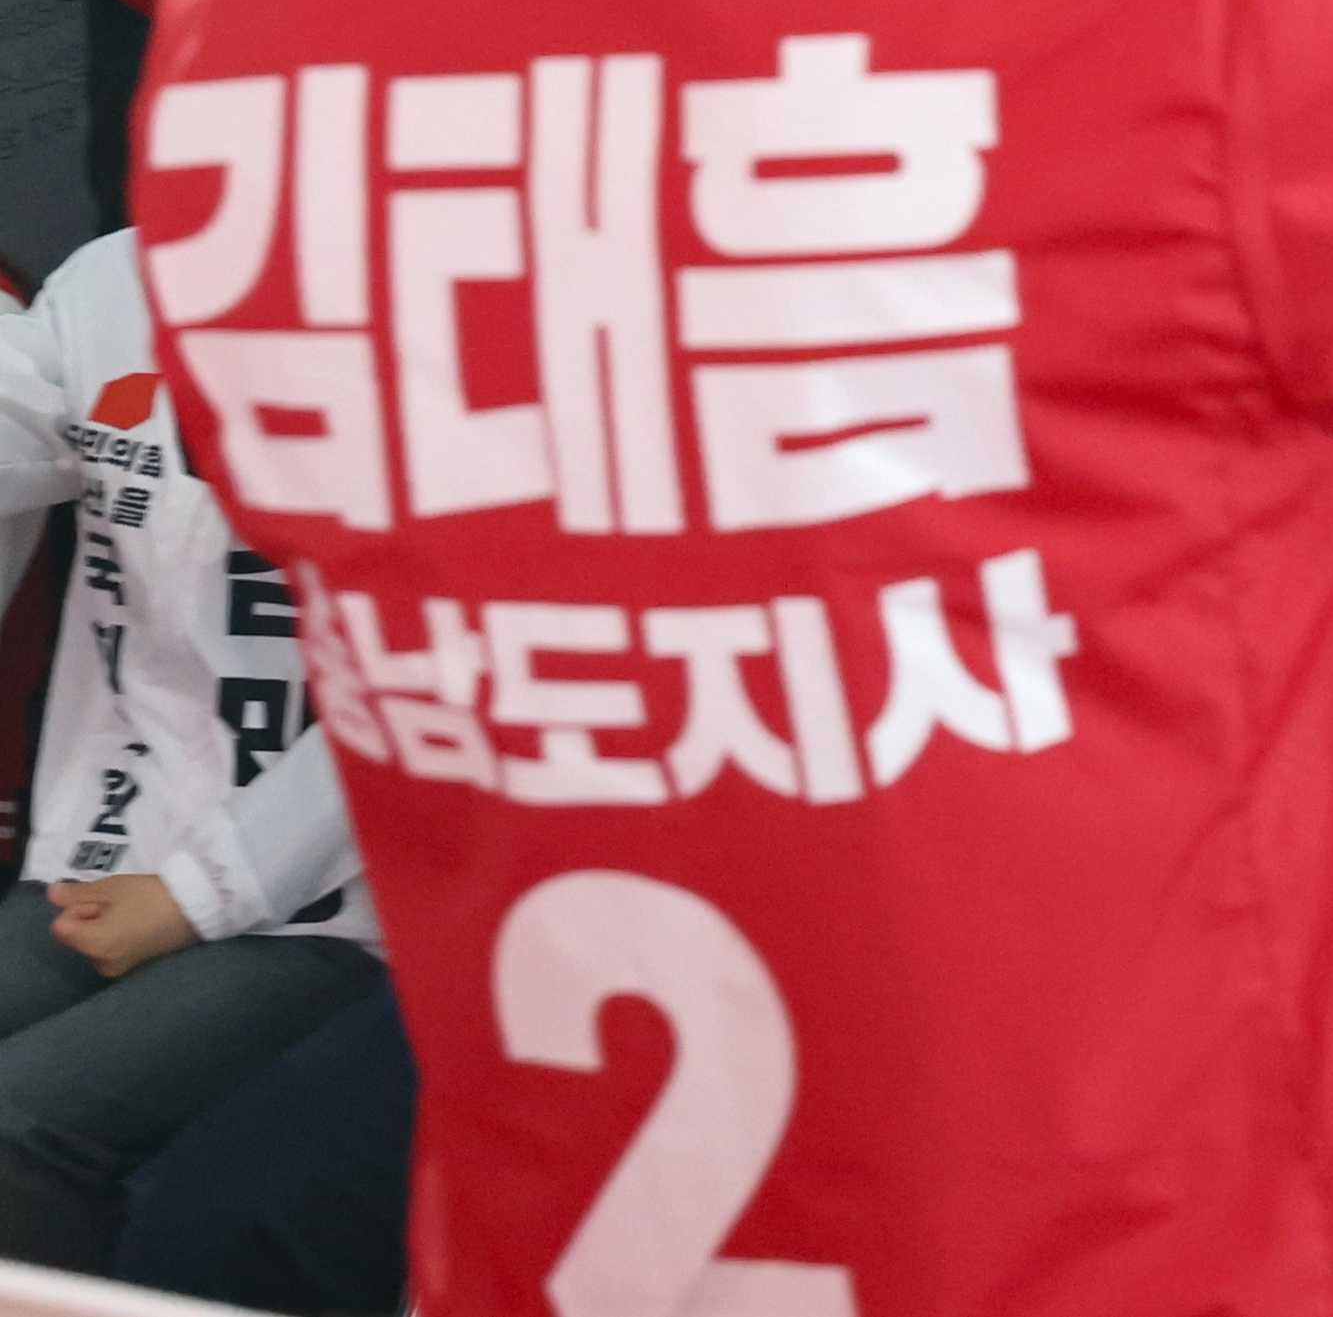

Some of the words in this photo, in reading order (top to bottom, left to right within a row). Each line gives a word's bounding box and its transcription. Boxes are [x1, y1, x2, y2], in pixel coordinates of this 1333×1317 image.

[146, 31, 1031, 536] 김태흠
[293, 547, 1079, 808] 충남도지사
[489, 868, 861, 1317] 2
